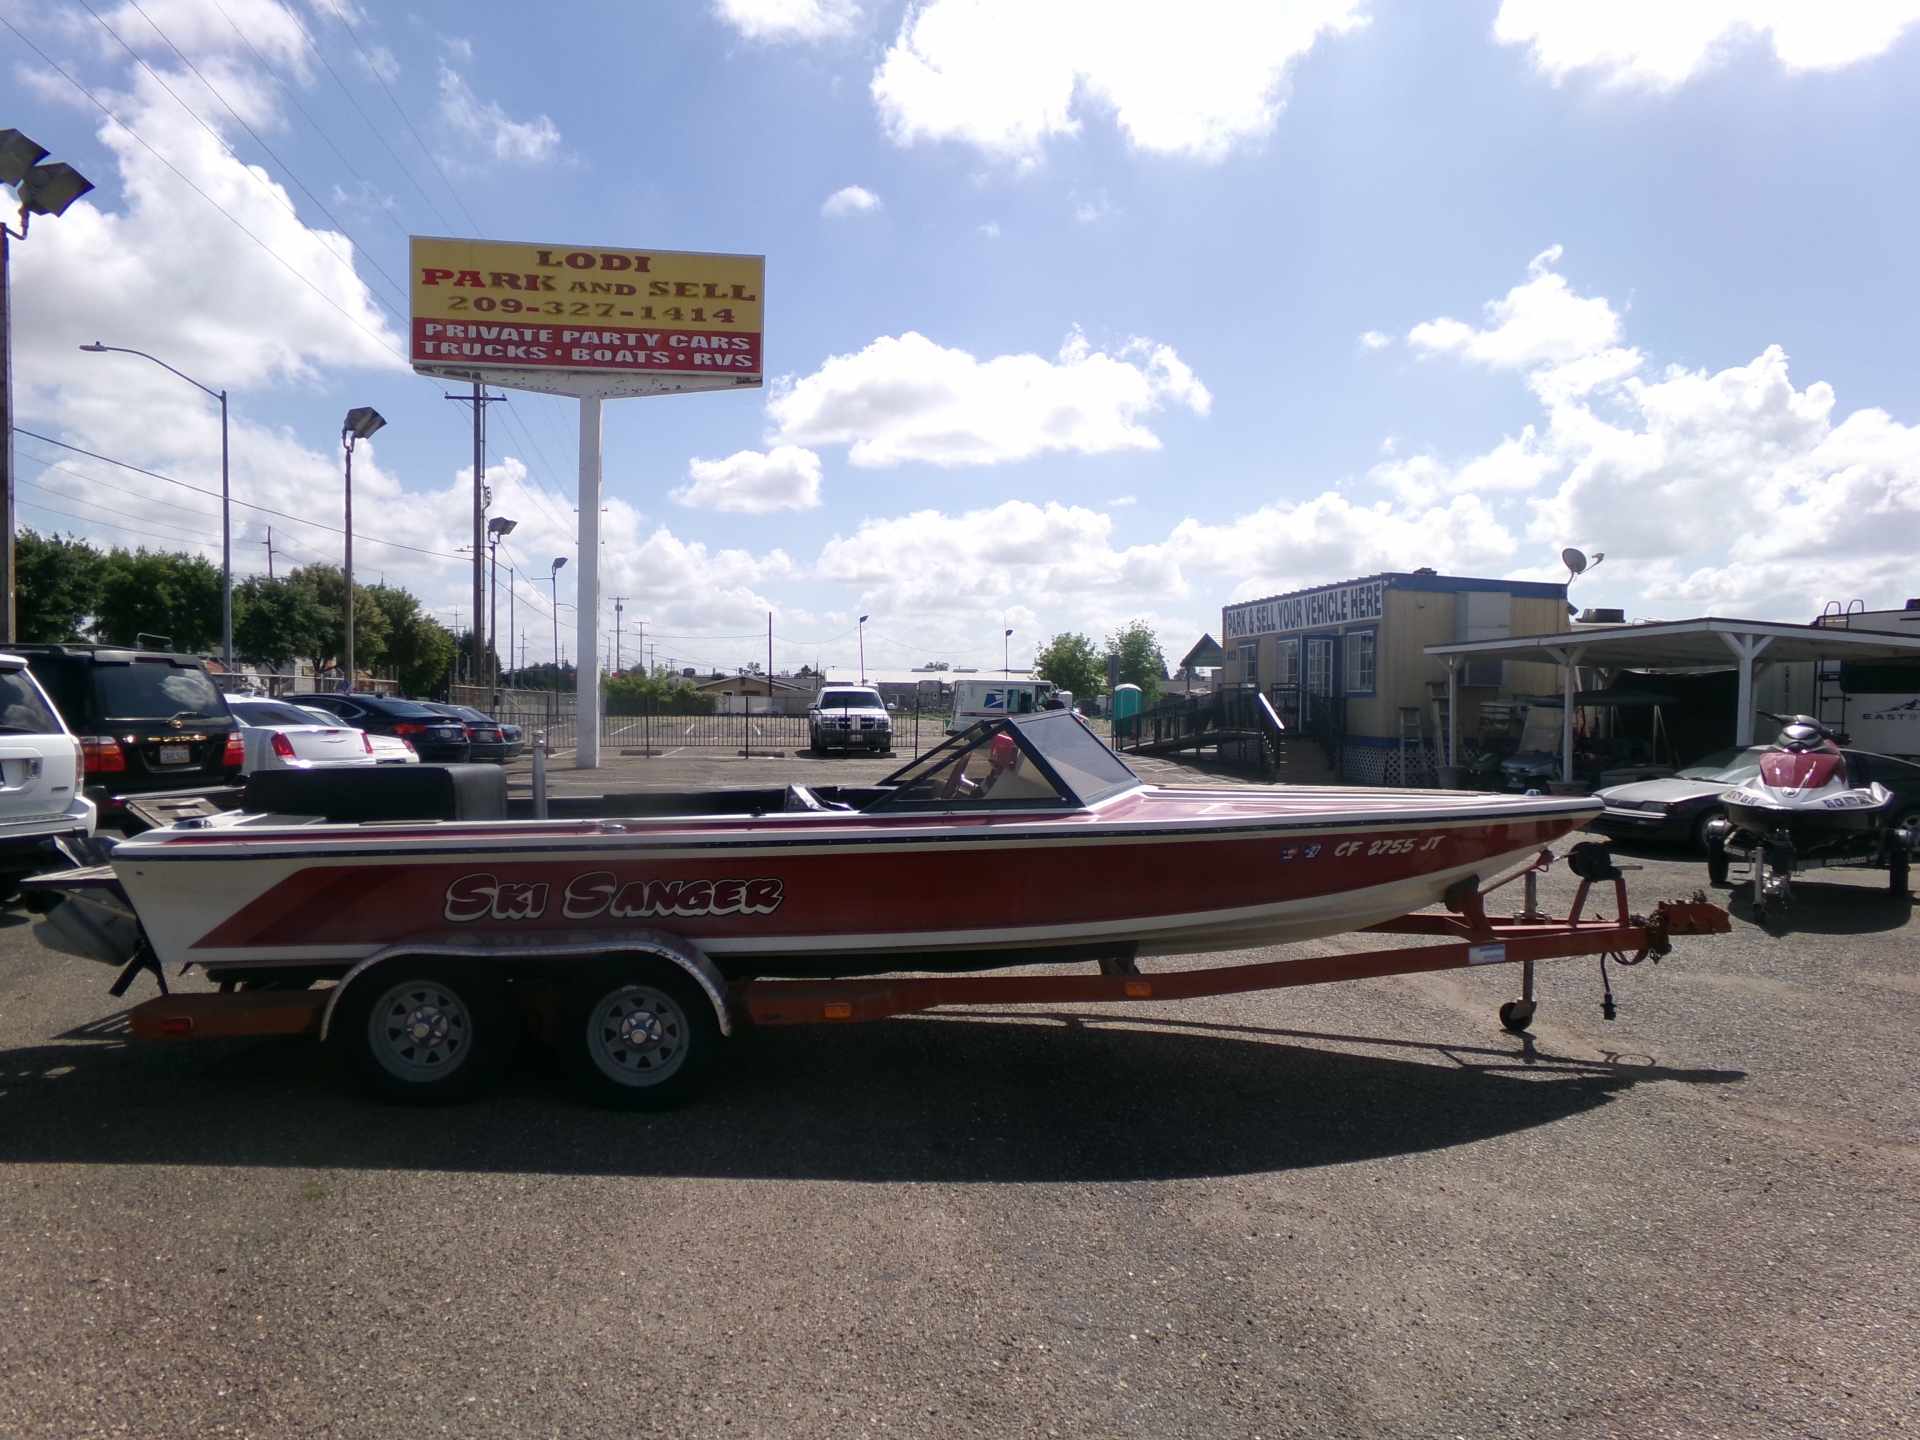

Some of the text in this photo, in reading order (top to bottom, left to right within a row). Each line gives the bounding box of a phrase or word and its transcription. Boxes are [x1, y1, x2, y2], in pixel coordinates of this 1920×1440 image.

[536, 250, 651, 273] LODI
[421, 267, 756, 302] PARK AND SELL
[447, 295, 735, 323] 209-327-1414
[425, 323, 750, 350] PRIVATE PARTY CARS
[420, 340, 753, 367] TRUCKS BOATS RVS
[1227, 583, 1382, 637] PARK & SELL YOUR VEHICLE HERE
[1334, 835, 1446, 857] CF 2755 JT
[444, 870, 785, 922] SKI SANGER
